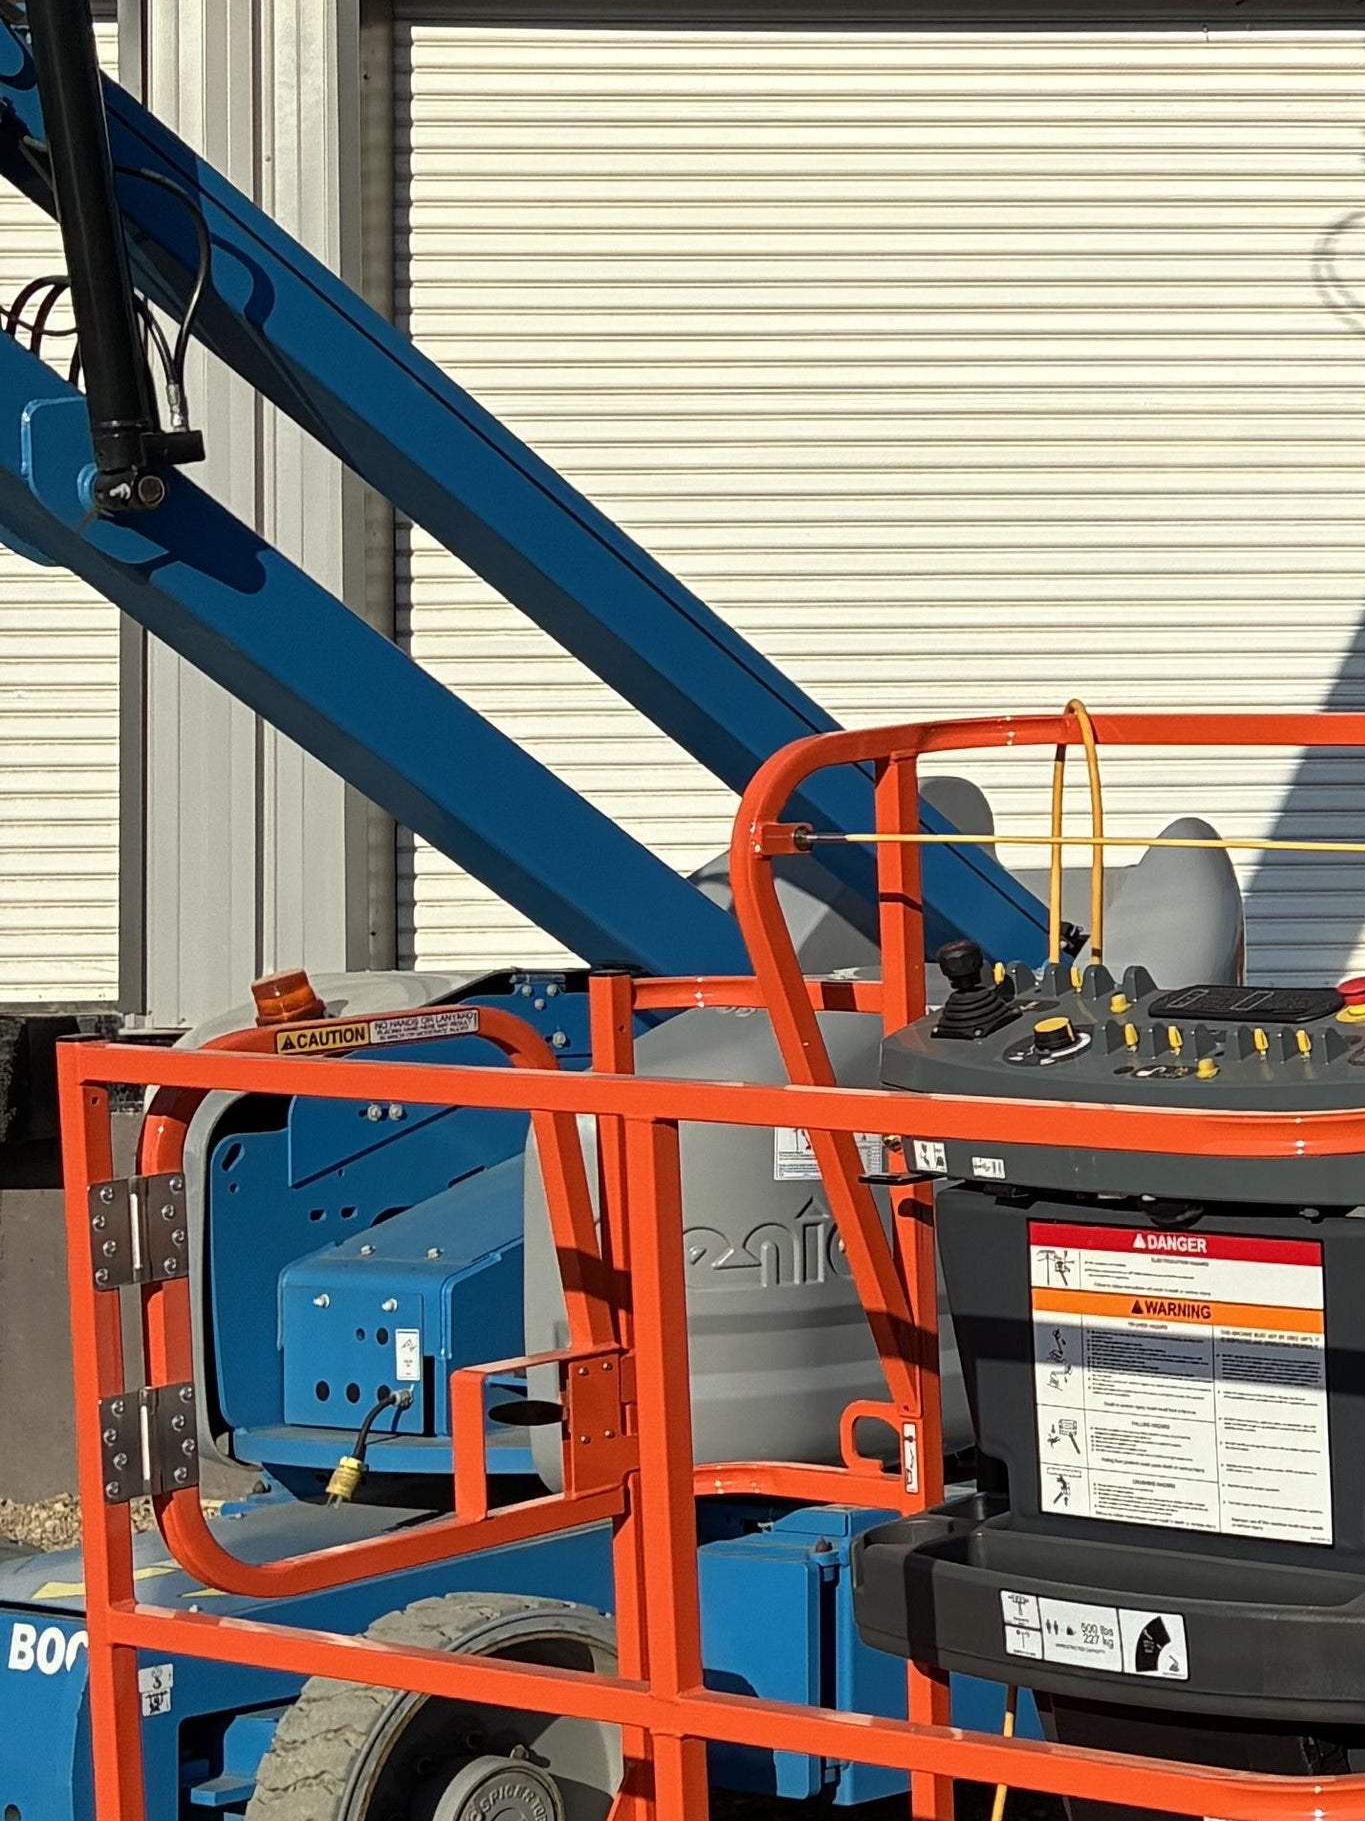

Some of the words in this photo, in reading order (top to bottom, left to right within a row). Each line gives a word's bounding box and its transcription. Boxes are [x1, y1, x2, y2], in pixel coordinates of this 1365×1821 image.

[297, 1026, 365, 1048] CAUTION
[1146, 1234, 1207, 1254] DANGER
[1145, 1300, 1212, 1320] WARNING
